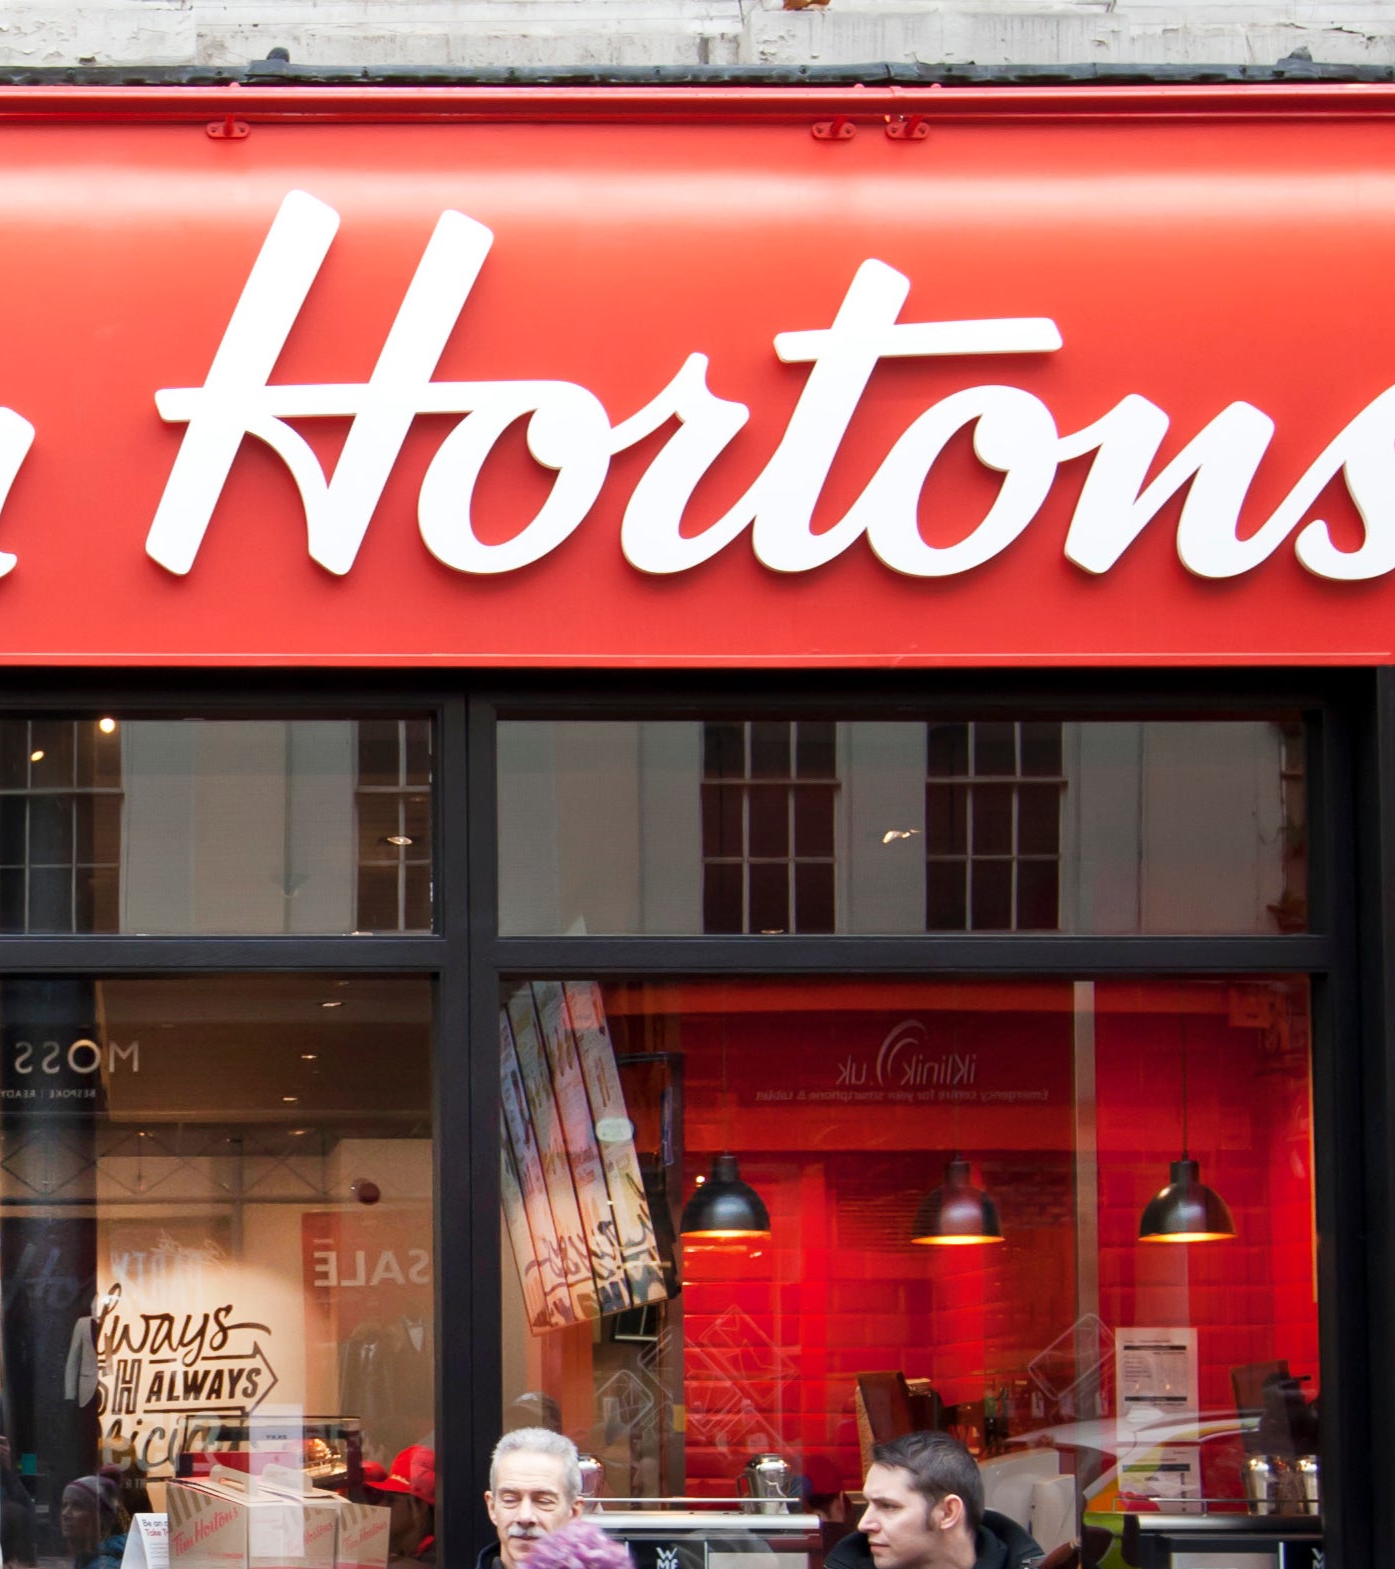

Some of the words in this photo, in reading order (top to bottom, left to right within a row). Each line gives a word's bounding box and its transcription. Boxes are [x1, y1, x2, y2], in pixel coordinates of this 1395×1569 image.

[145, 1368, 262, 1404] ALWAYS
[173, 1531, 193, 1557] Tim
[194, 1507, 239, 1540] Hortons
